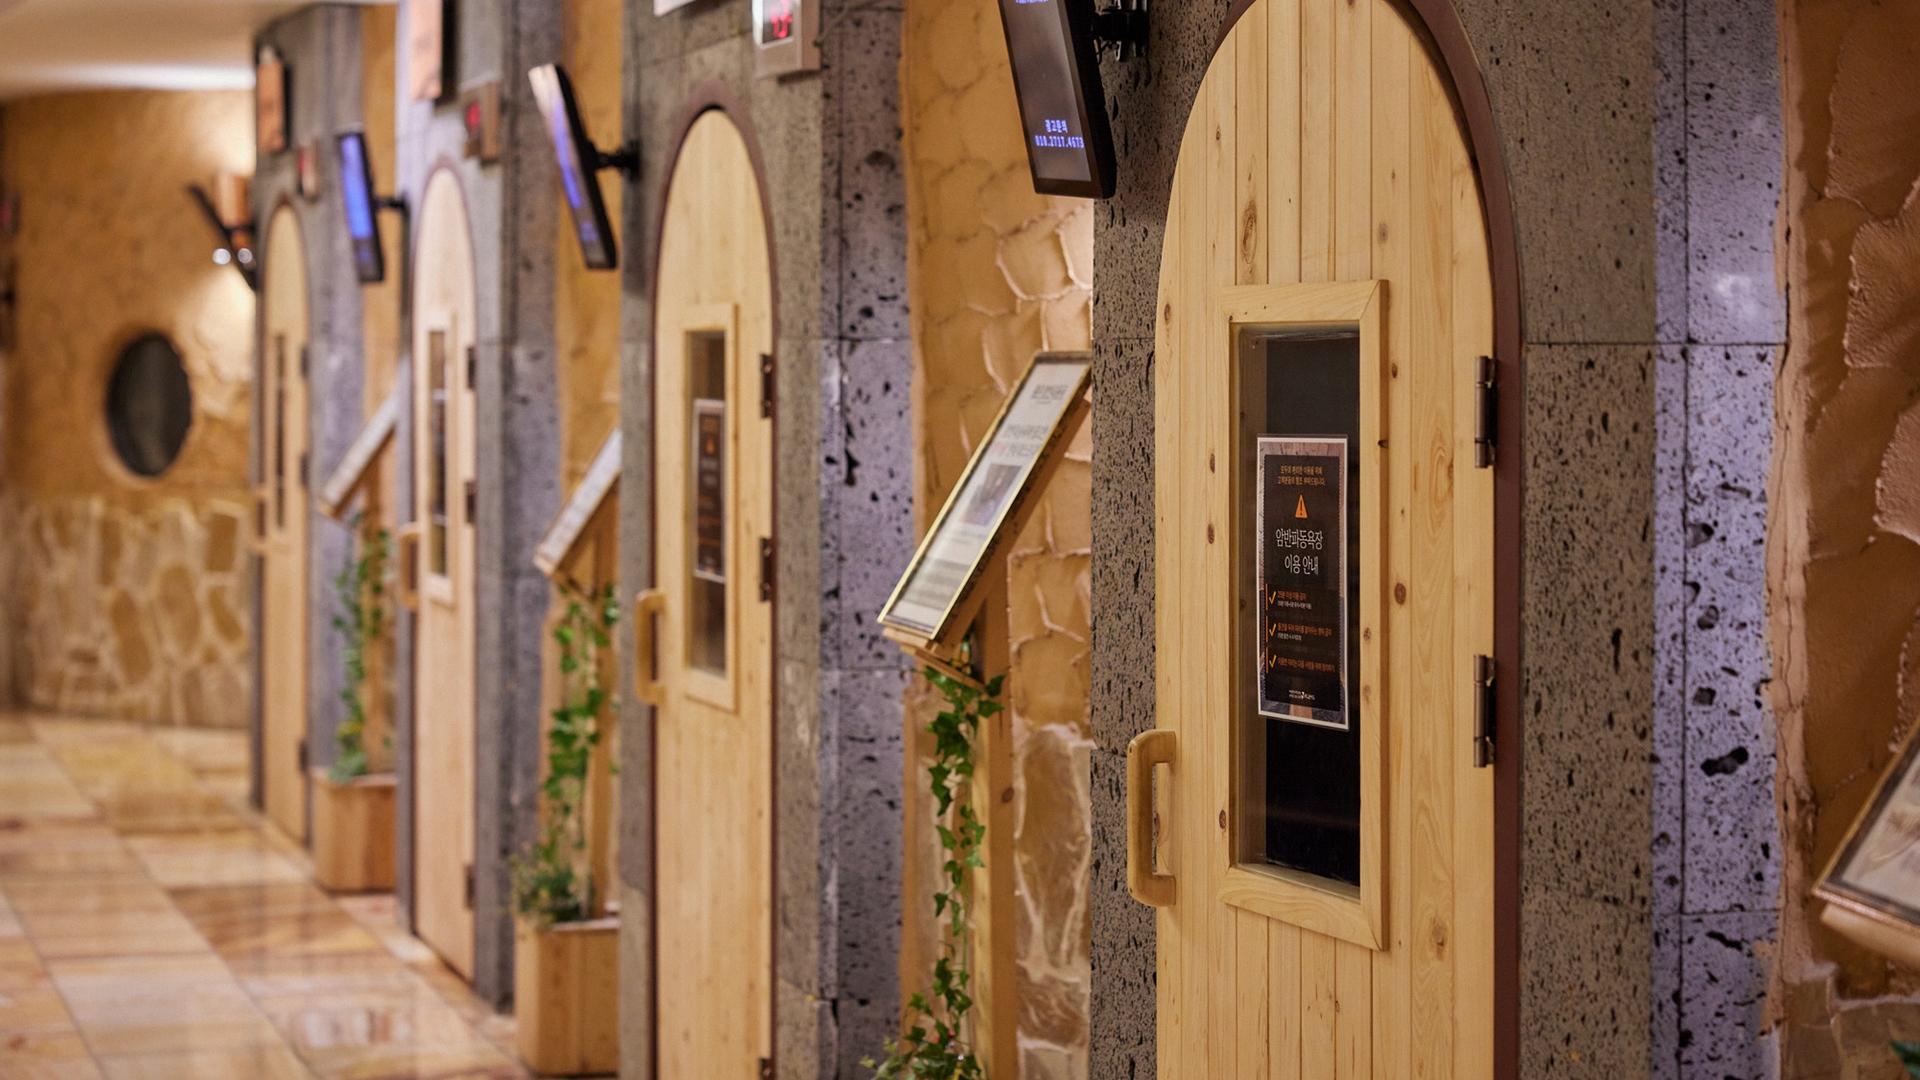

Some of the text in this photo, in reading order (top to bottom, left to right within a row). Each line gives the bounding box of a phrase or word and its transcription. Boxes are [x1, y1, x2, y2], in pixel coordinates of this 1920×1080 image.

[1044, 119, 1068, 133] 광고문의
[1275, 528, 1323, 550] 암반파동욕장
[1284, 554, 1319, 576] 이용 안내
